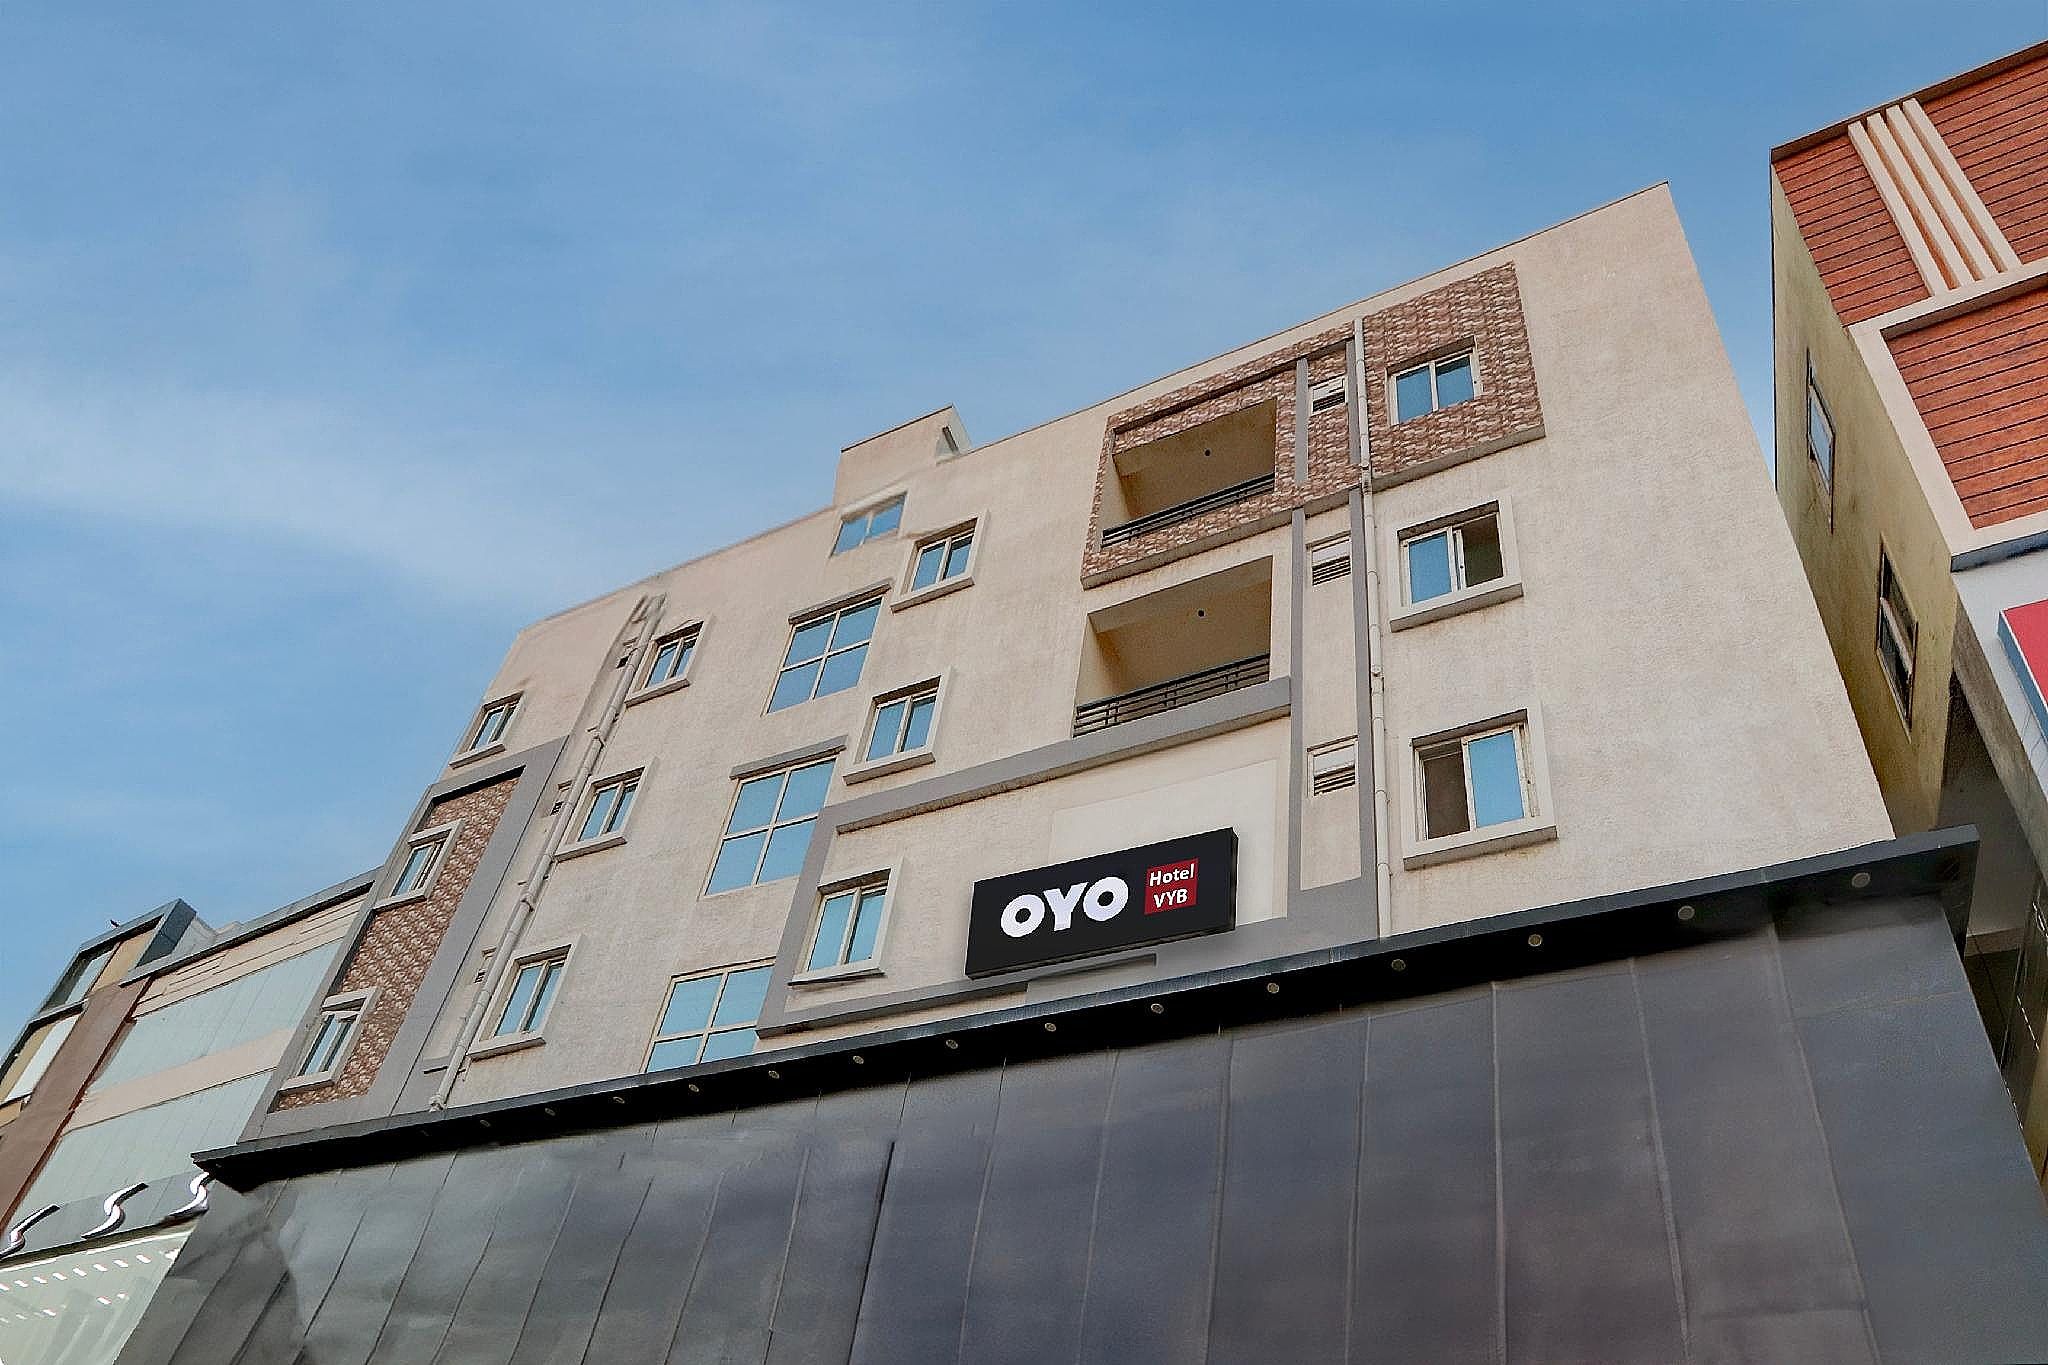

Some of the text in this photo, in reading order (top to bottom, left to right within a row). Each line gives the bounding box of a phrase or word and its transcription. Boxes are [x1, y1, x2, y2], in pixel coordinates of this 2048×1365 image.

[1149, 863, 1195, 888] Hotel
[1000, 876, 1129, 938] OYO
[1153, 888, 1188, 909] VYB
